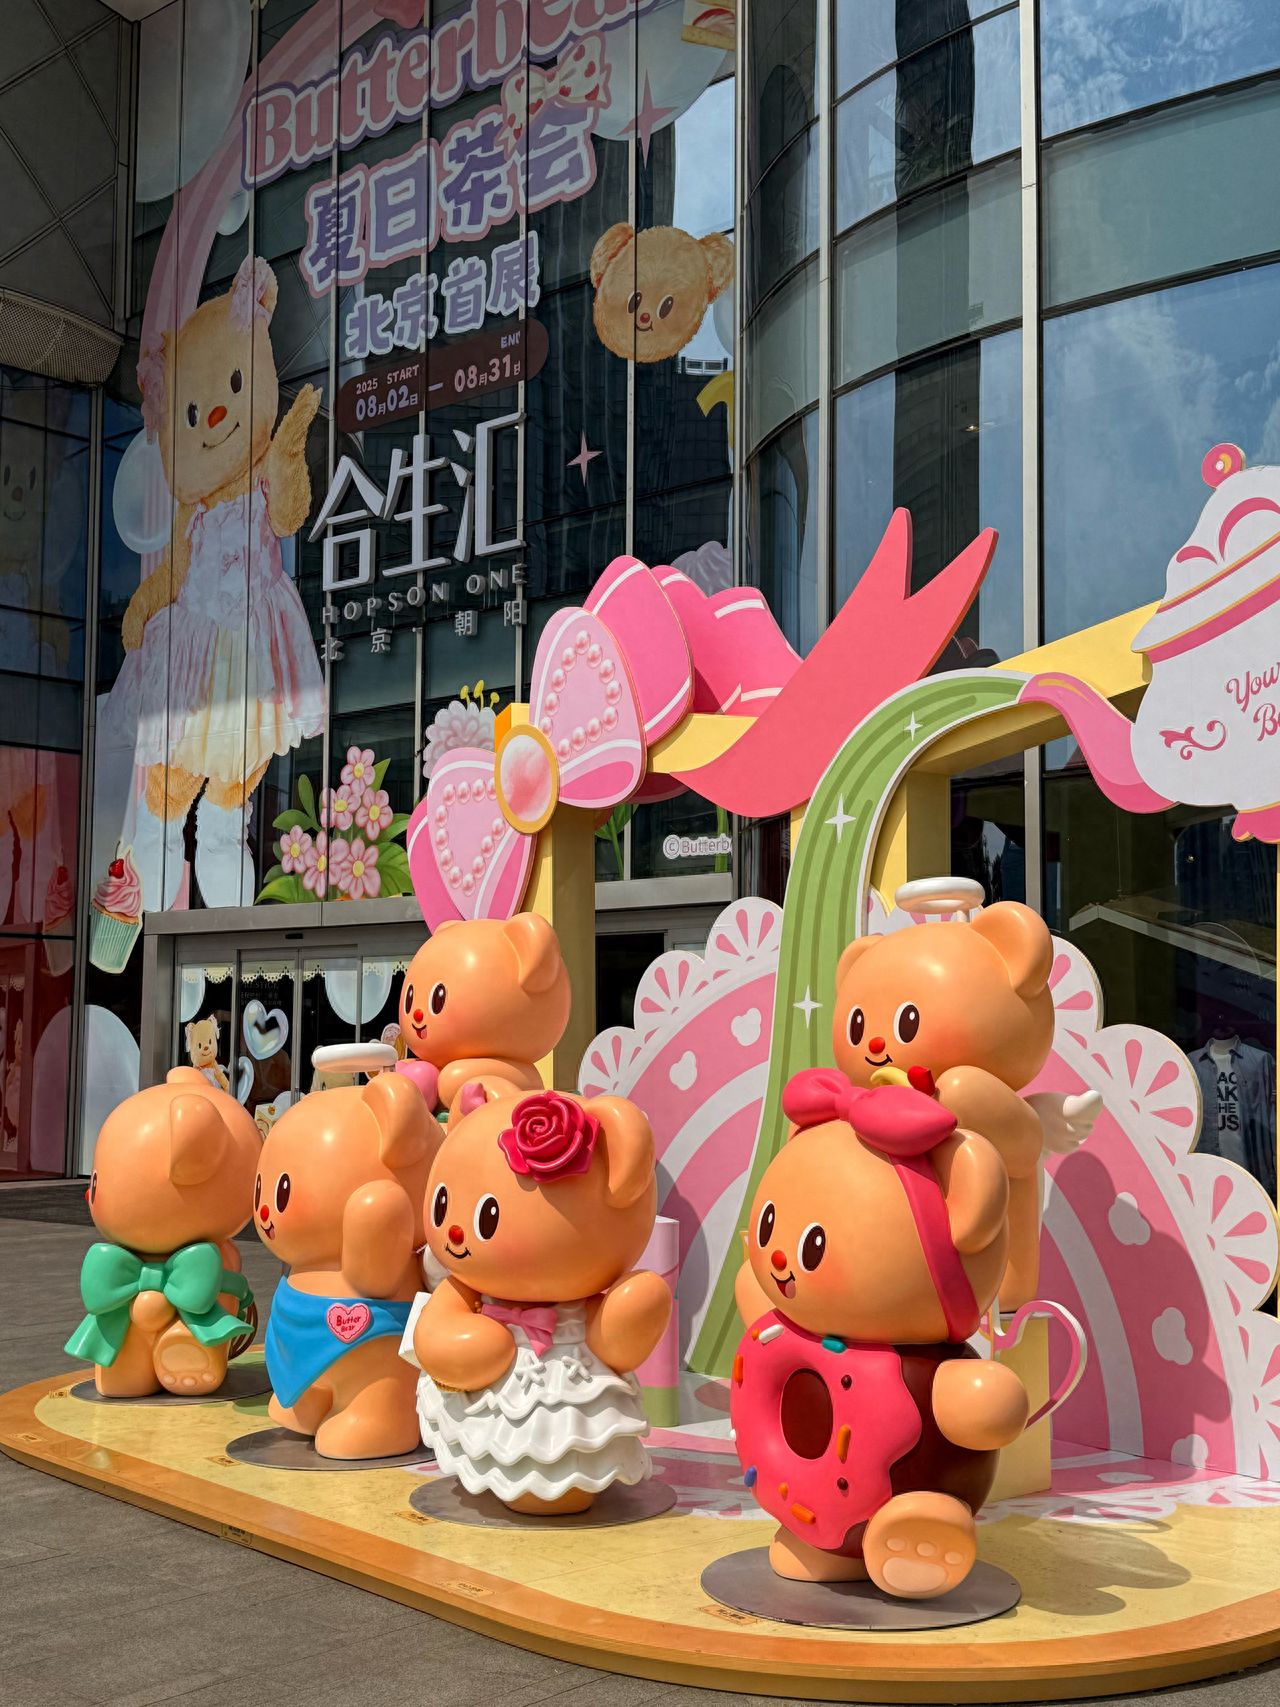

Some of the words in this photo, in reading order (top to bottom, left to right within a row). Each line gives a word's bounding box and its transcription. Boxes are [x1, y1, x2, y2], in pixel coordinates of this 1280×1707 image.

[302, 101, 597, 298] 夏日茶会
[344, 231, 541, 358] 北京首展
[356, 377, 379, 395] 2025
[386, 364, 420, 385] START
[308, 411, 527, 592] 合生汇
[322, 585, 450, 625] HOPSON
[465, 563, 528, 596] ONE
[1226, 661, 1280, 713] You
[336, 1315, 361, 1326] Butter
